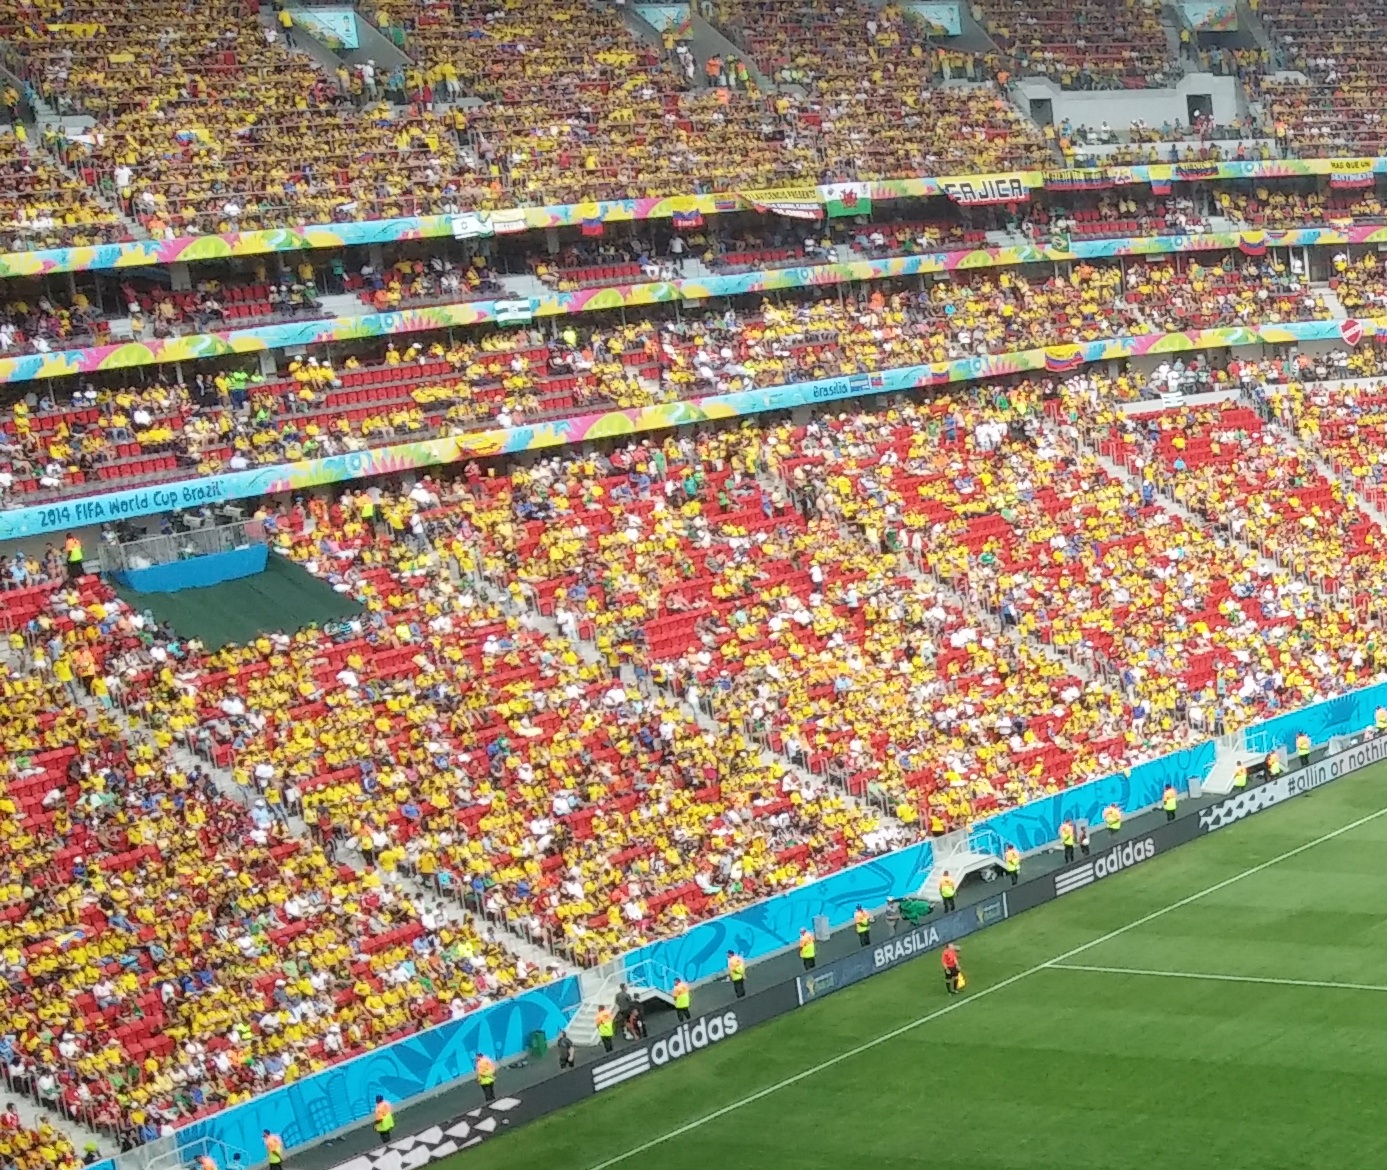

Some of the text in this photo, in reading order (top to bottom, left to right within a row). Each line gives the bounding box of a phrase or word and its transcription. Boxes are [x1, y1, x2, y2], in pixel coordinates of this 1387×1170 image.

[38, 508, 71, 528] 2014
[75, 502, 106, 521] FIFA
[109, 493, 149, 514] World
[153, 490, 177, 508] Cup
[1287, 765, 1326, 796] #allin
[1330, 758, 1345, 776] or
[1094, 837, 1155, 878] adidas
[873, 926, 940, 968] BRASÍLIA
[650, 1011, 739, 1065] adidas
